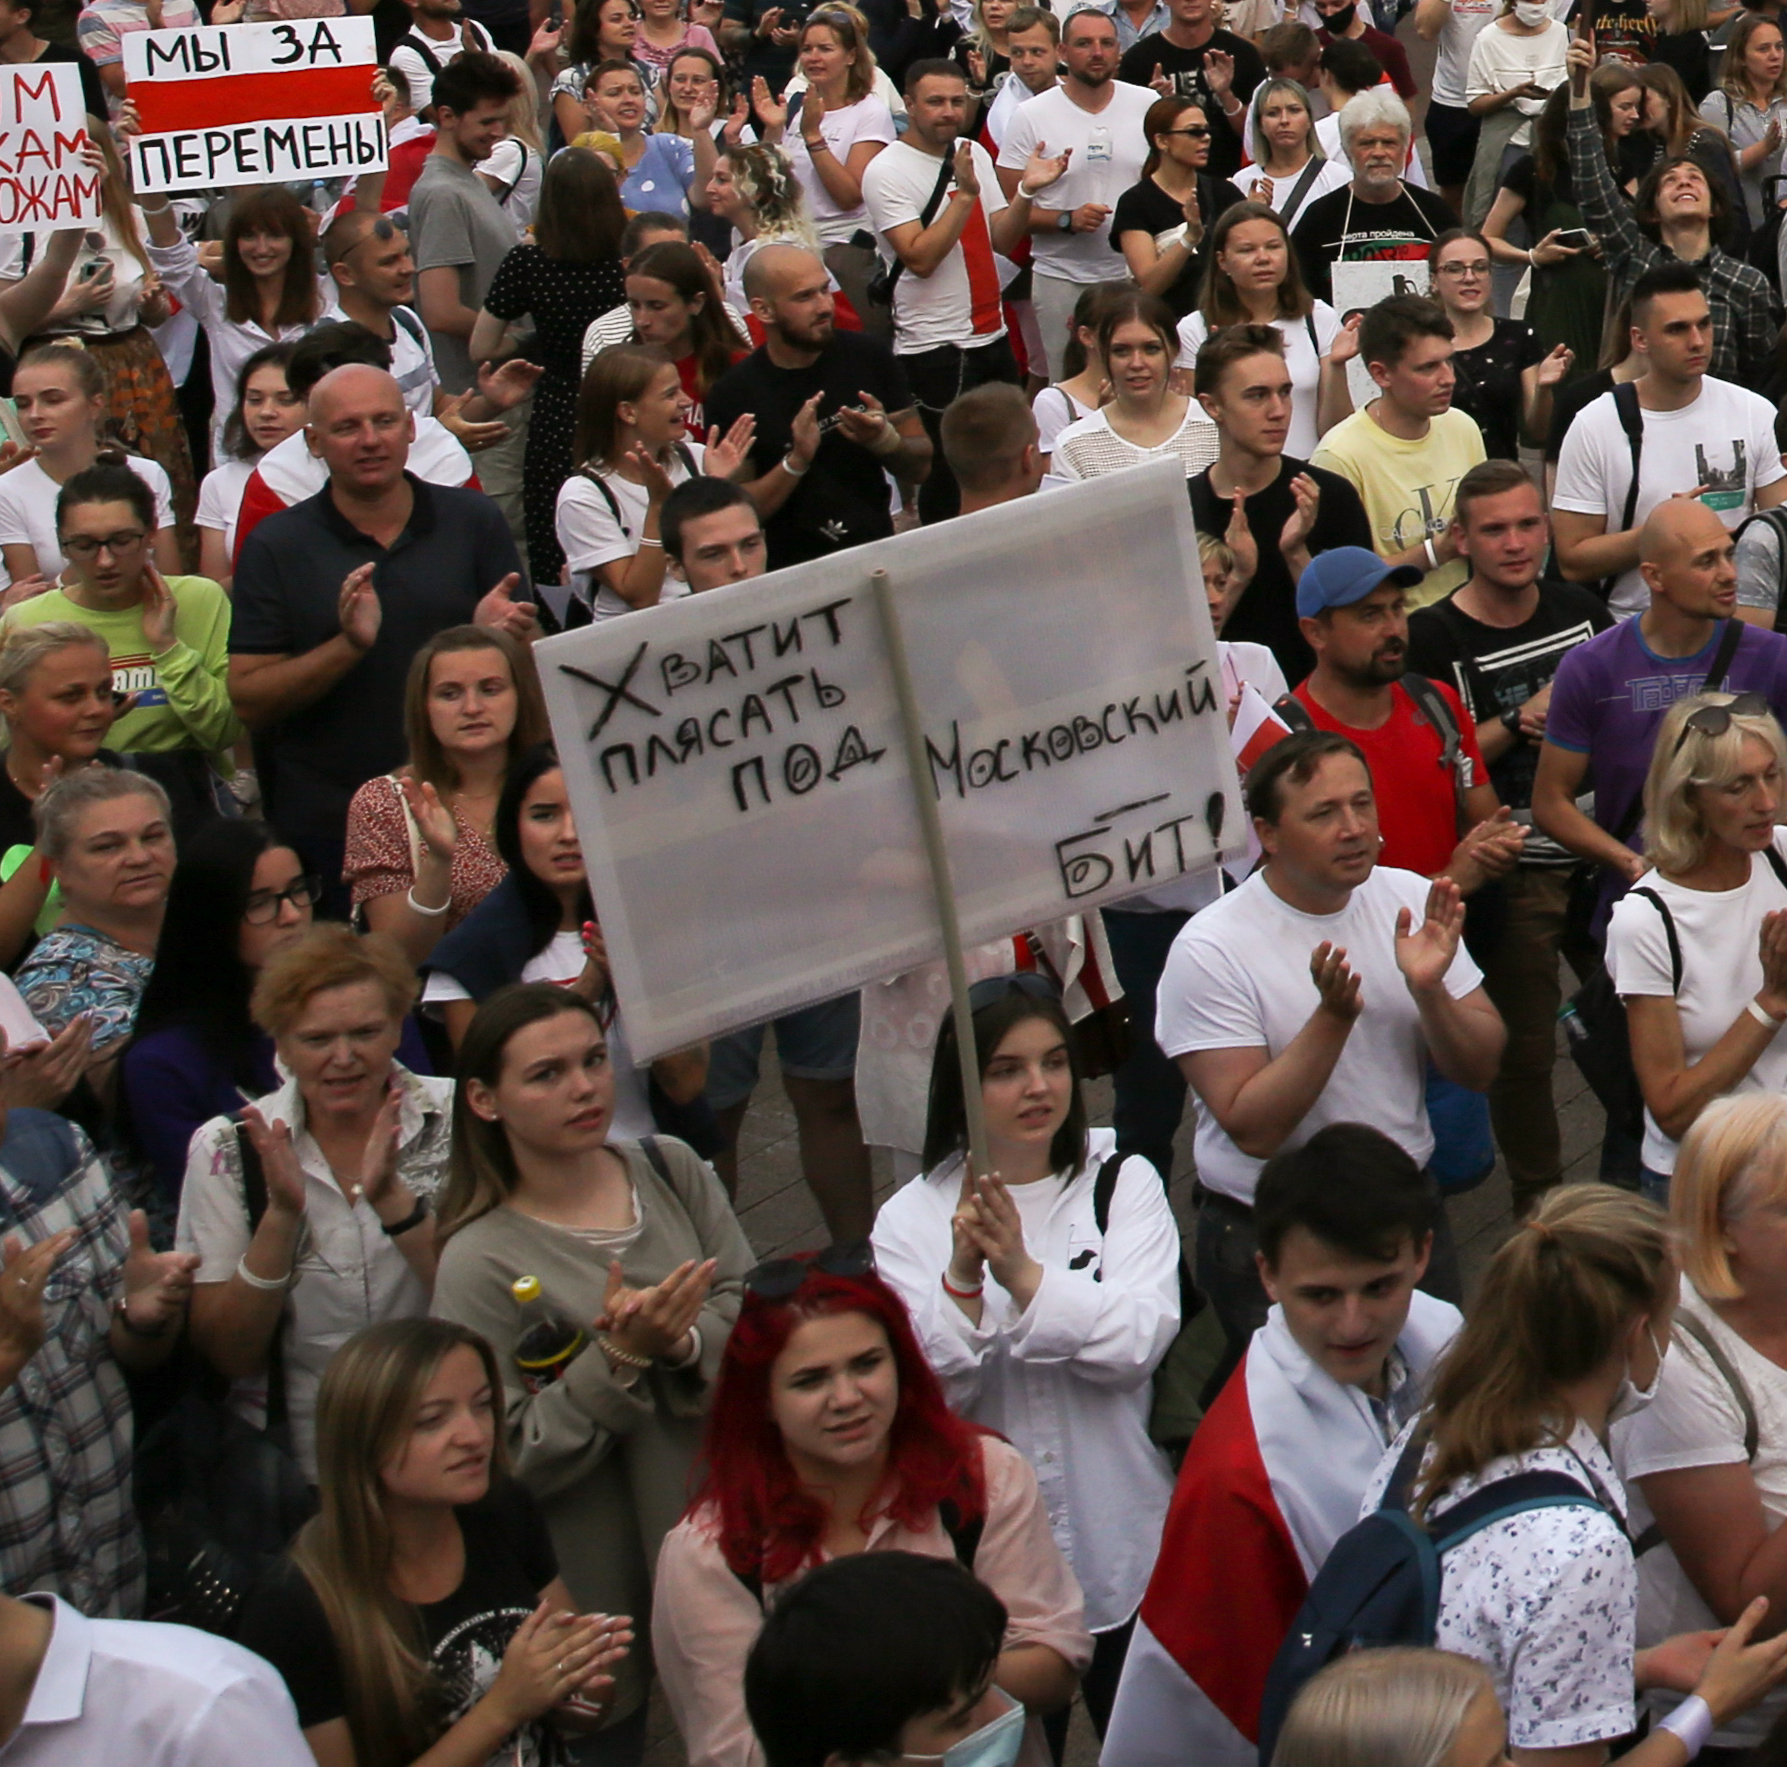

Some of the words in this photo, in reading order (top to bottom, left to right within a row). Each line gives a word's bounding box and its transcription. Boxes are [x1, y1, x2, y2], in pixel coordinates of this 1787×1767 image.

[147, 31, 231, 76] МЫ
[270, 20, 344, 65] ЗА
[139, 119, 385, 186] ПЕРЕМЕНЫ
[558, 597, 853, 742] ХВАТИТ
[601, 667, 847, 794] ПЛЯСАТЬ
[730, 724, 887, 812] ПОД
[1055, 791, 1226, 899] БИТ!
